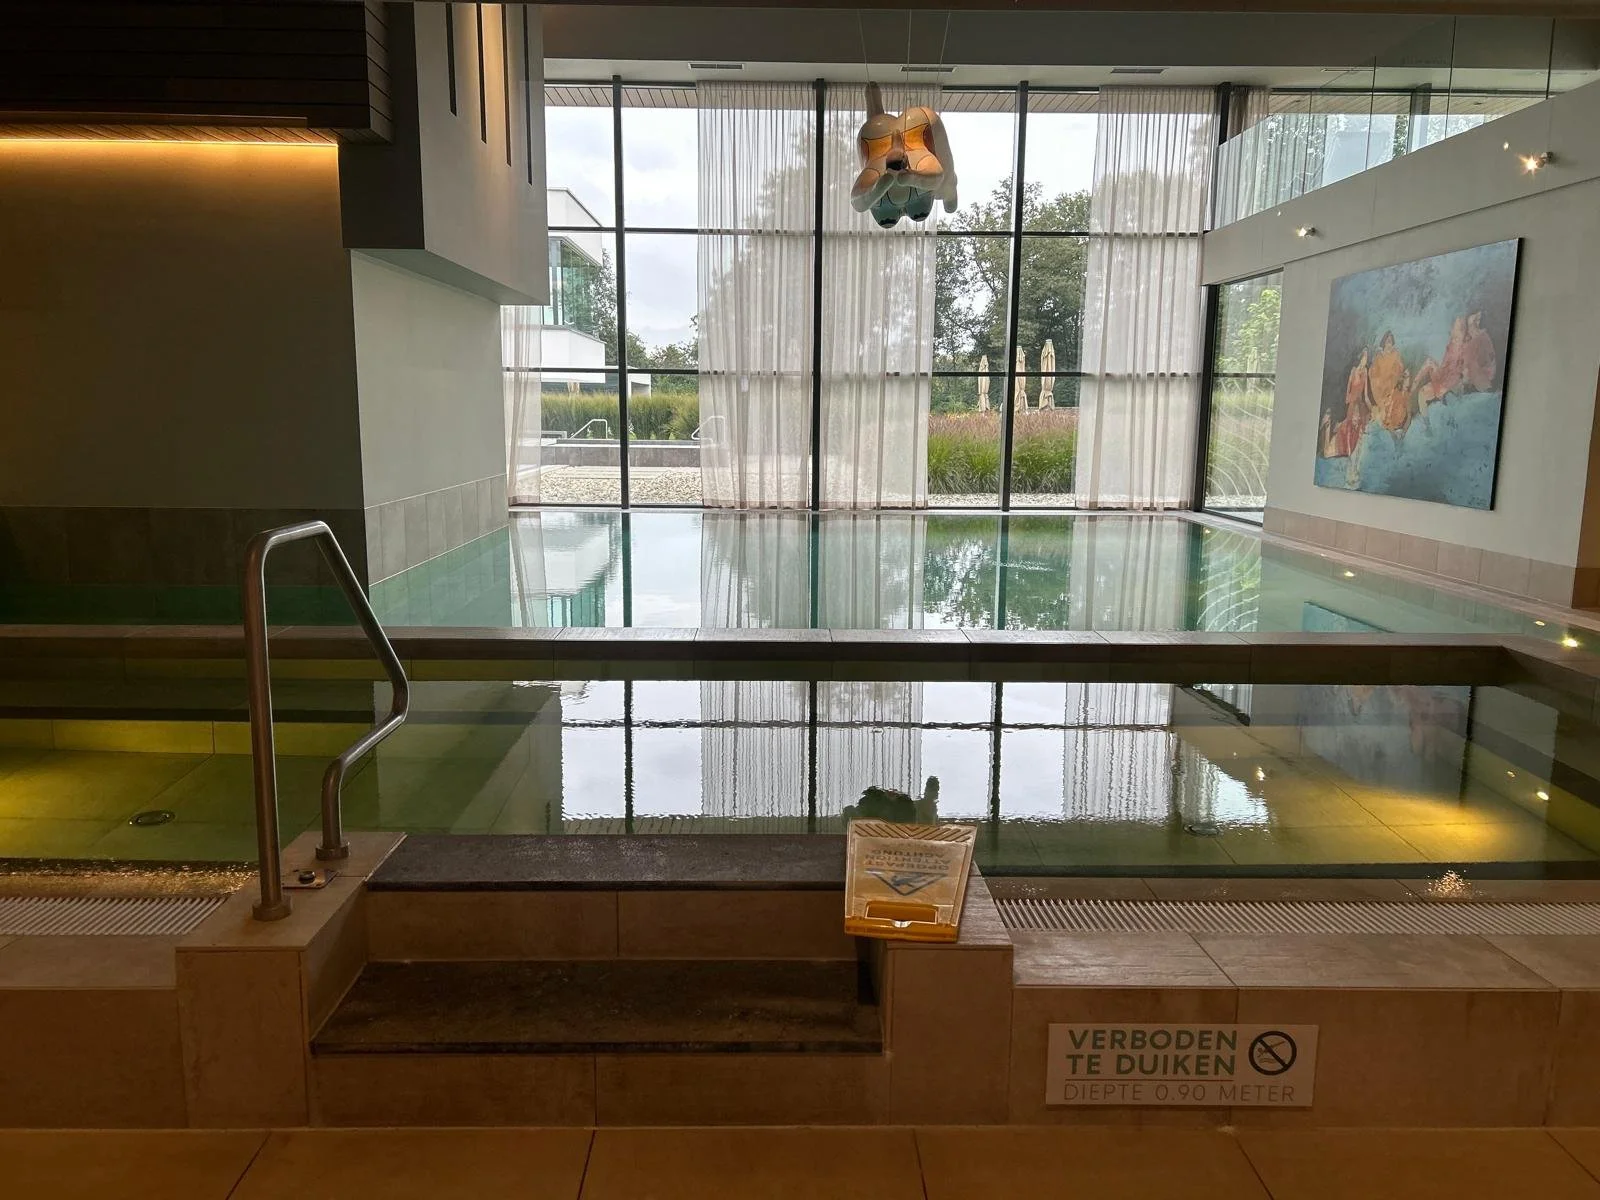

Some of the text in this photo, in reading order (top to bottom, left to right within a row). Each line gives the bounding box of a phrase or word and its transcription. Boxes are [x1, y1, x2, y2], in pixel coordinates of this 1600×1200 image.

[864, 854, 952, 865] ATTENTION
[871, 849, 944, 859] ACHTUNG
[865, 860, 950, 871] OPGEPAST
[1068, 1029, 1237, 1051] VERBODEN
[1065, 1054, 1236, 1076] TE DUIKEN
[1063, 1083, 1295, 1102] DIEPTE 0.90 METER
